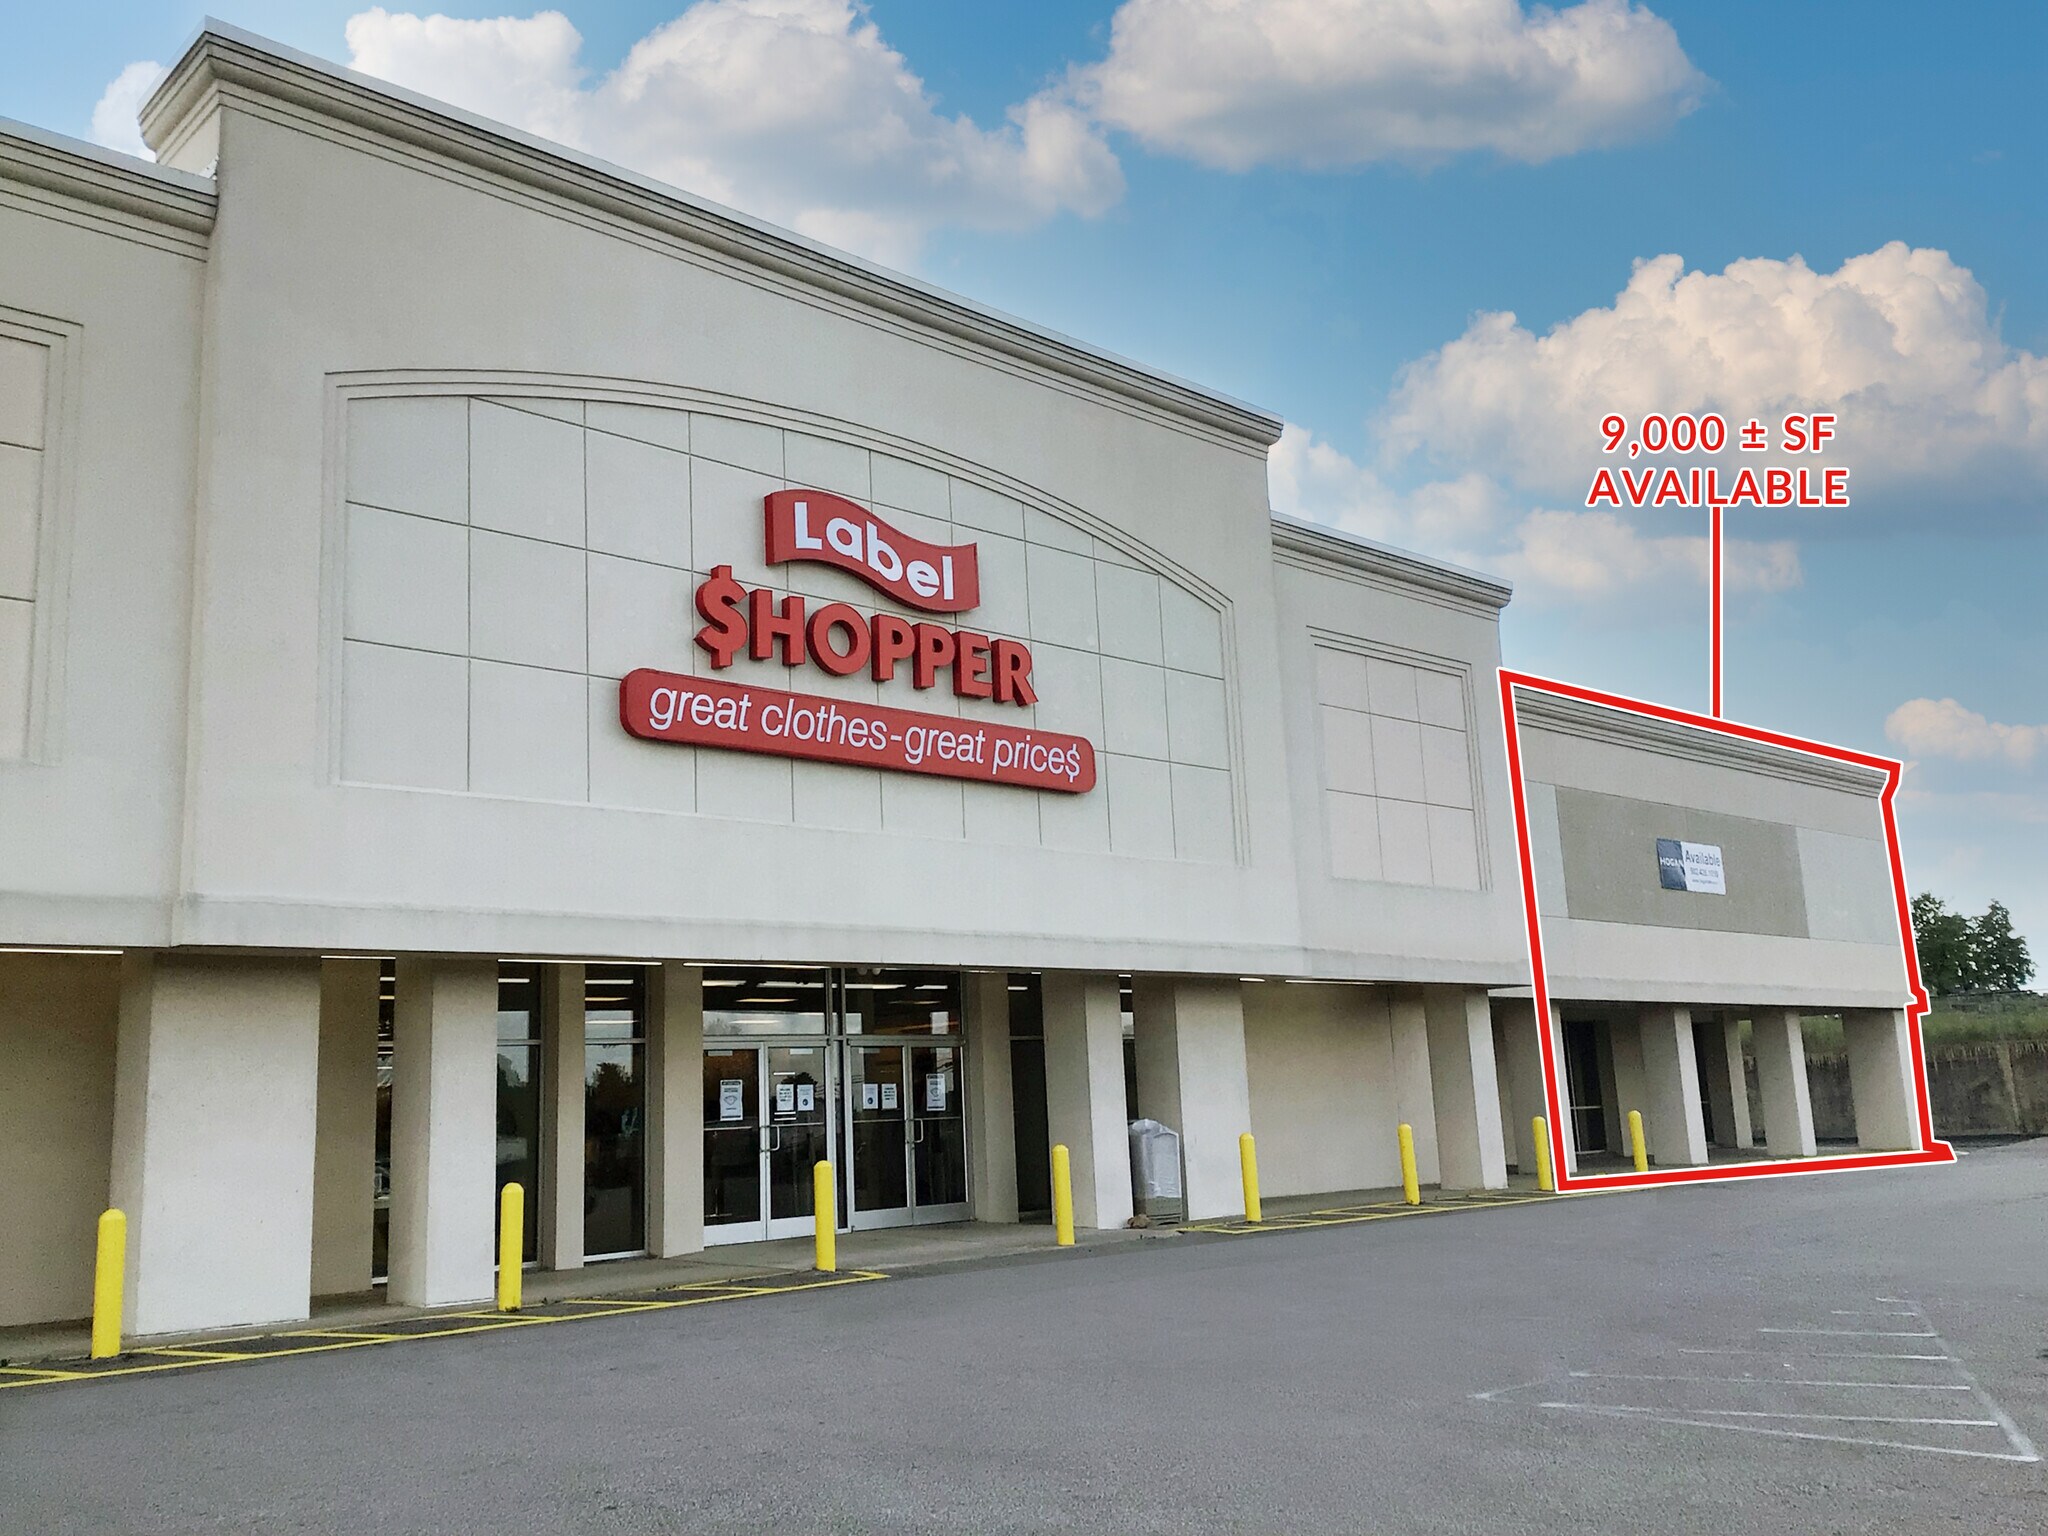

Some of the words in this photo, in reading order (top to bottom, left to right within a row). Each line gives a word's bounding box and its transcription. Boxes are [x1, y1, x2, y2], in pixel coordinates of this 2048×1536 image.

[794, 501, 955, 600] Label
[693, 565, 1039, 707] $HOPPER
[649, 687, 752, 732] great
[1685, 850, 1721, 867] Available
